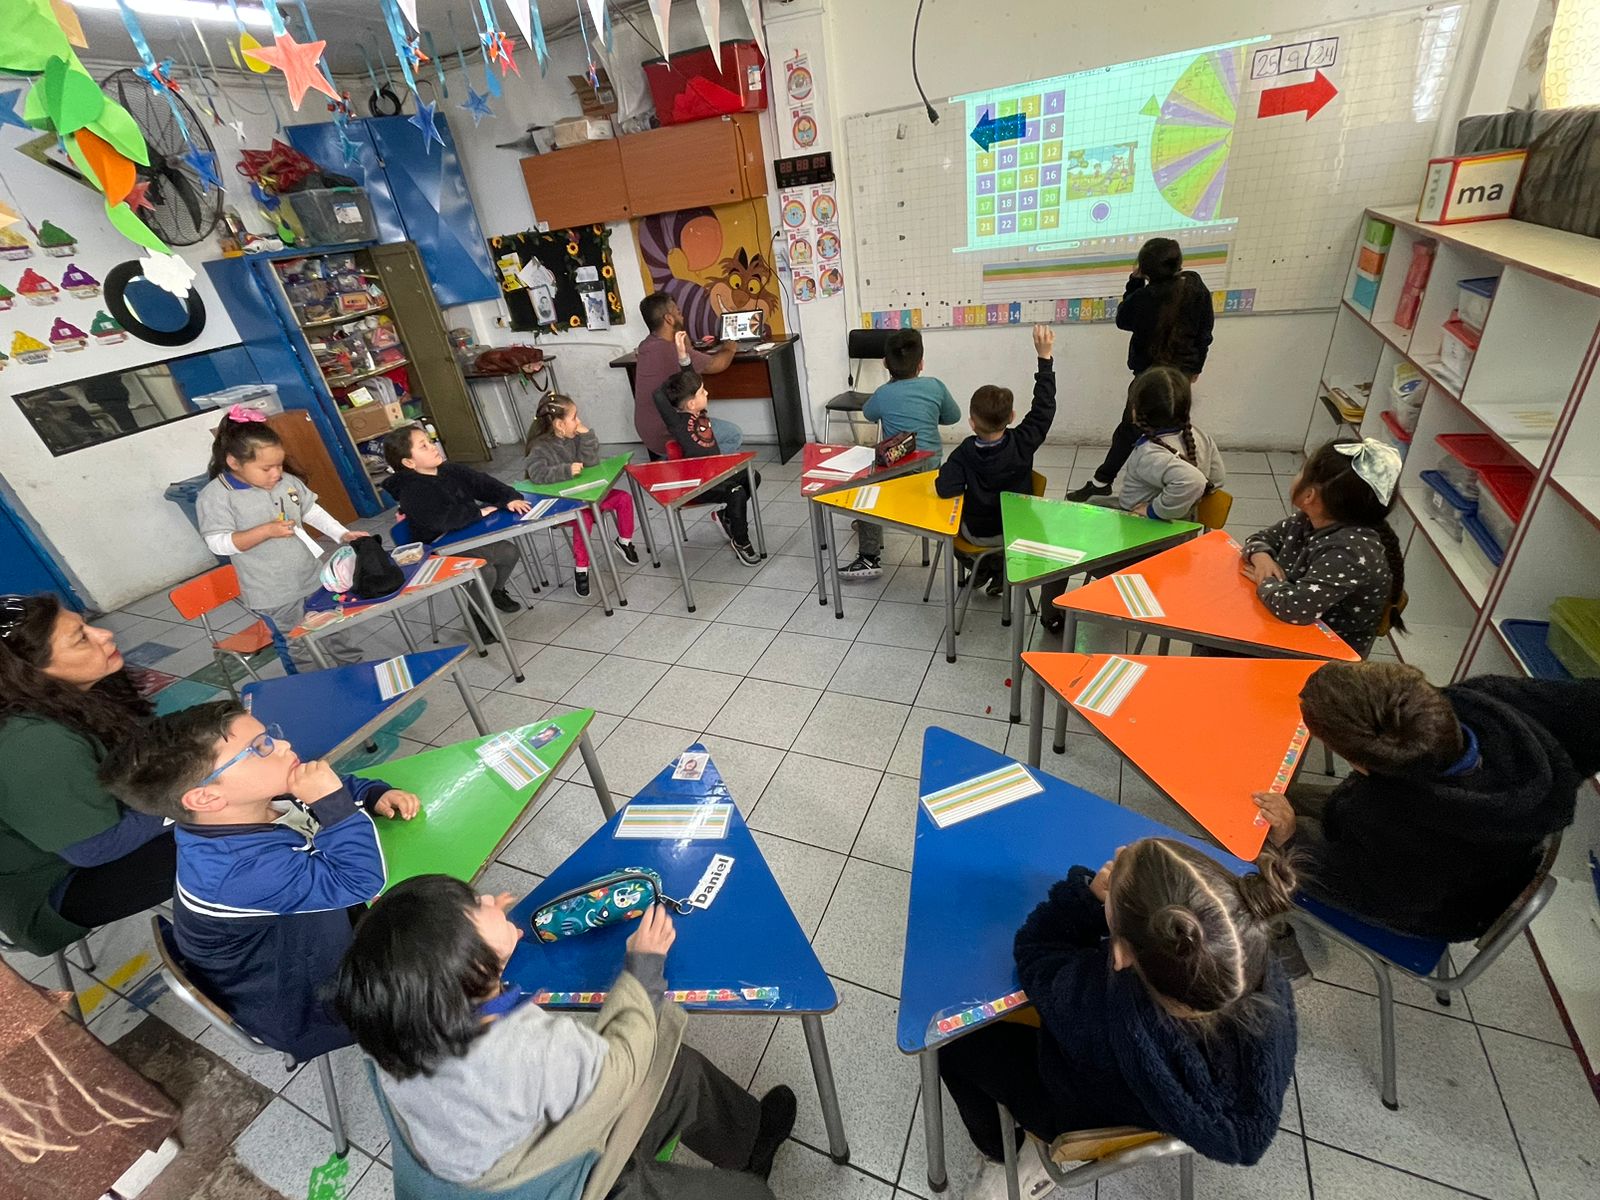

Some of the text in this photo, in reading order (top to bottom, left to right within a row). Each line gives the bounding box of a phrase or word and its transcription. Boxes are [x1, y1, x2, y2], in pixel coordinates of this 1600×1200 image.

[1256, 54, 1277, 76] 25
[1287, 50, 1299, 70] 9
[1028, 102, 1033, 111] 3
[1050, 98, 1057, 108] 4
[1027, 123, 1056, 137] 7 8
[982, 147, 1057, 167] 9 10 11 12
[981, 170, 1057, 189] 13 14 15 16
[981, 193, 1056, 211] 17 18 19 20
[1457, 183, 1504, 205] ma
[981, 215, 1055, 231] 21 22 23 24
[964, 313, 975, 323] 10
[987, 312, 997, 321] 12
[998, 311, 1008, 321] 13
[1009, 310, 1020, 320] 14
[1056, 307, 1067, 317] 18
[1068, 307, 1080, 317] 19
[1081, 307, 1092, 317] 20
[1105, 307, 1117, 318] 22
[694, 858, 730, 904] Daniel
